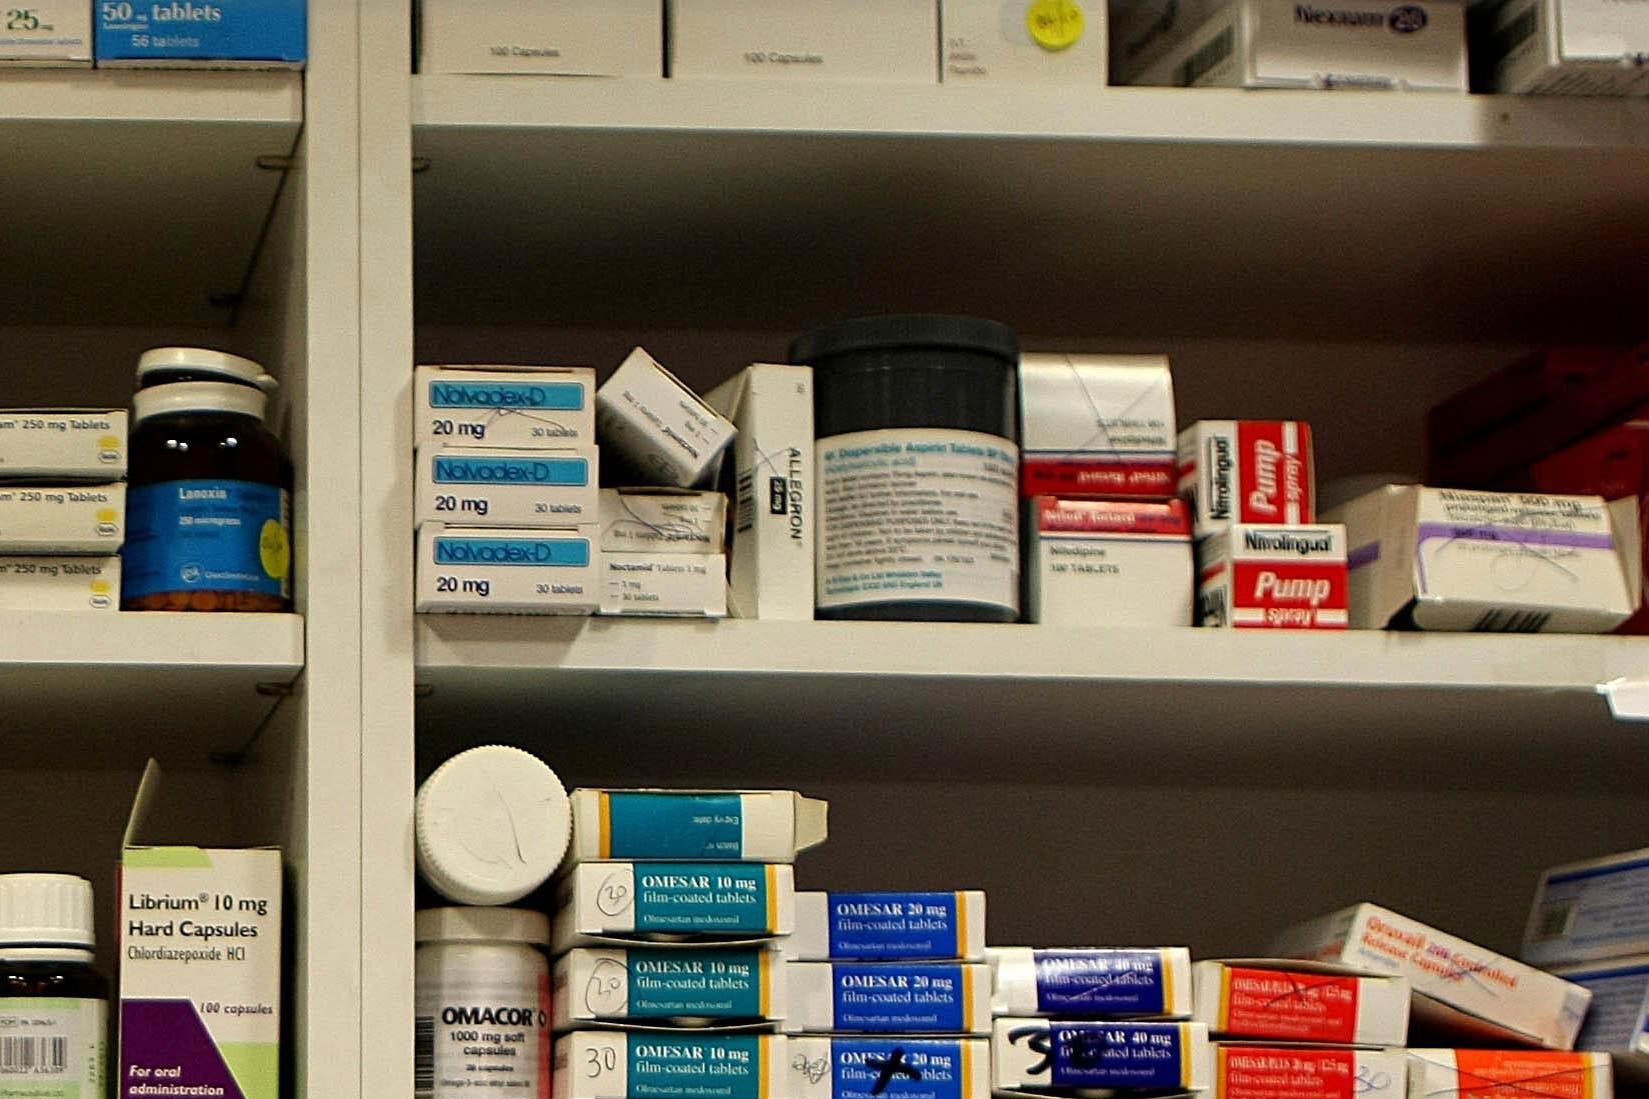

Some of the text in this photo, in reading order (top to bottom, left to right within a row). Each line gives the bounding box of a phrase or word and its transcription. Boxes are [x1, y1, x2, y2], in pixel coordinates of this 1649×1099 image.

[154, 2, 221, 21] tablets
[8, 10, 39, 31] 25
[21, 419, 44, 430] 250
[49, 422, 66, 433] mg
[70, 419, 110, 431] Tablets
[788, 447, 802, 540] ALLEGRON
[437, 542, 551, 562] Nolvadex-D
[437, 578, 490, 597] 20 mg
[1255, 572, 1331, 605] Pump
[642, 876, 756, 892] OMESAR 10 mg
[214, 895, 233, 911] 10
[238, 898, 267, 915] mg
[643, 891, 756, 904] film-coated tablets
[837, 903, 947, 918] OMESAR 20 mg
[129, 921, 257, 940] Hard Capsules
[838, 917, 947, 930] film-coated tablets
[128, 946, 222, 963] Chlordiazepoxide
[200, 1002, 273, 1016] 100 capsules
[442, 1007, 532, 1026] OMACOR
[451, 1031, 525, 1046] 1000 mg soft
[463, 1046, 516, 1058] capsules
[129, 1065, 181, 1078] For oral
[128, 1083, 224, 1097] administration
